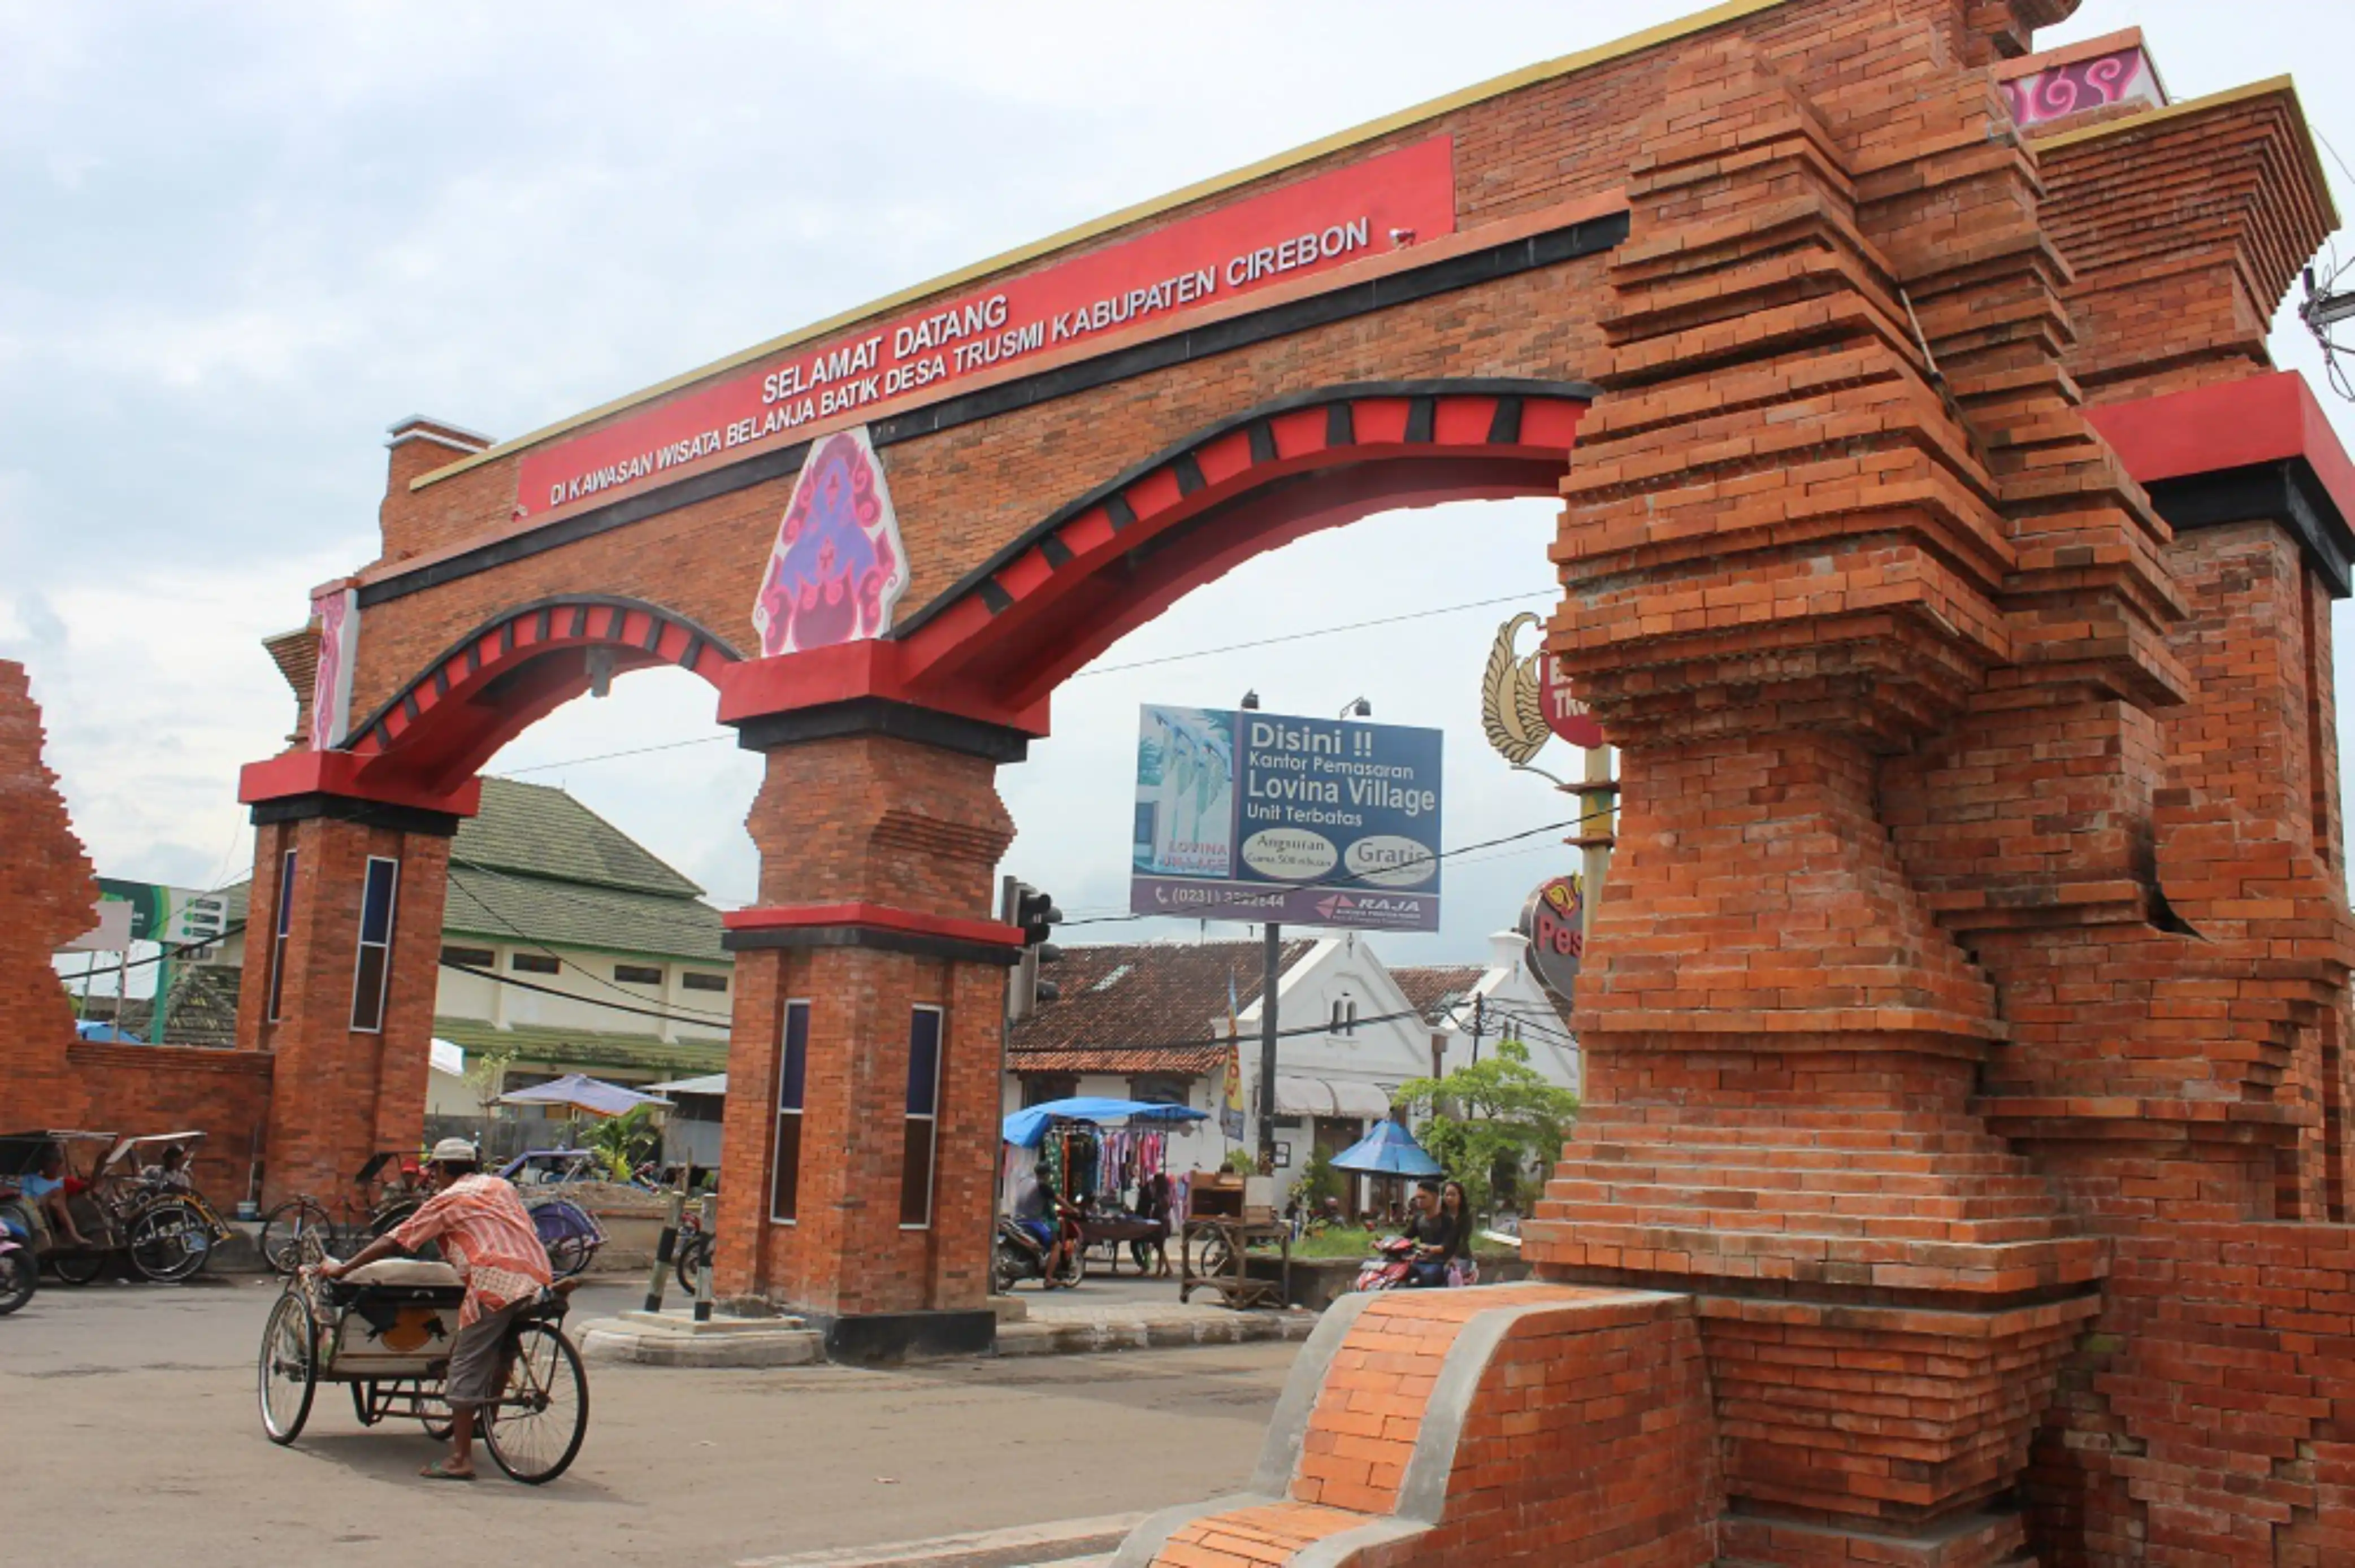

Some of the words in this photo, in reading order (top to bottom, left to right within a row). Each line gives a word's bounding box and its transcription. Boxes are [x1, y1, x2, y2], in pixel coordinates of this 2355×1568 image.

[550, 483, 566, 506] DI
[569, 452, 653, 499] KAWASAN
[656, 430, 721, 469] WISATA
[725, 400, 816, 448] BELANJA
[820, 375, 879, 415] BATIK
[884, 355, 947, 394] DESA
[953, 322, 1044, 370] TRUSMI
[1052, 266, 1217, 341] KABUPATEN
[1226, 217, 1369, 286] CIREBON
[762, 336, 882, 403] SELAMAT
[894, 294, 1008, 360] DATANG
[1251, 723, 1341, 754] Disini
[1354, 732, 1372, 758] !!
[1250, 752, 1308, 771] Kantor
[1314, 758, 1413, 780] Pemasaran
[1249, 770, 1338, 803] Lovina
[1347, 778, 1435, 816] Village
[1247, 804, 1281, 820] Unit
[1286, 806, 1362, 827] Terbatas
[1358, 842, 1425, 862] Gratis
[1359, 898, 1420, 911] RAJA
